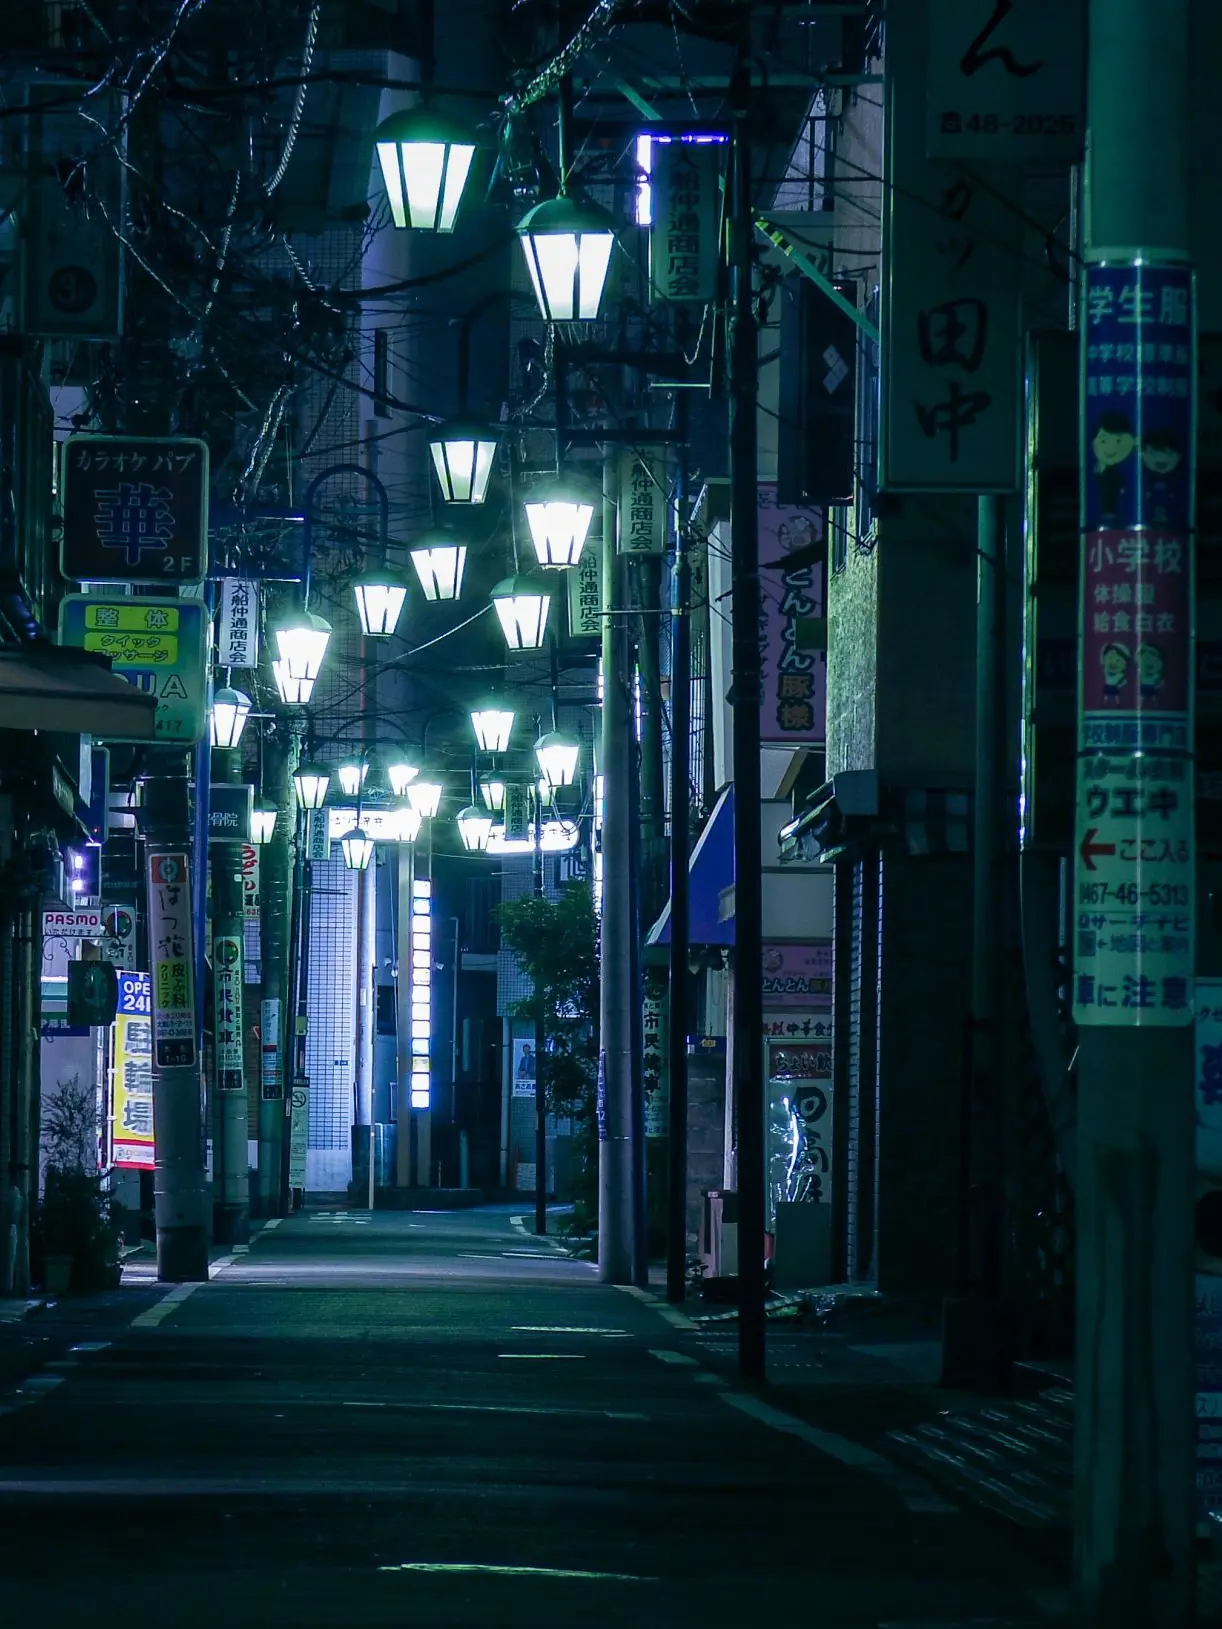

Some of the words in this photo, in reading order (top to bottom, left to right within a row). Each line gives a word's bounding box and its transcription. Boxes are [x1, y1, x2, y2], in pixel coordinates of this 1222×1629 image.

[966, 113, 1075, 134] 48-2025
[1088, 283, 1189, 326] 学生服
[914, 297, 992, 465] 田中
[630, 448, 654, 550] 大船仲通商店会
[93, 481, 176, 567] 華
[163, 556, 194, 573] 2F
[1089, 537, 1184, 574] 小学校
[95, 607, 169, 629] 整体
[229, 582, 250, 664] 大船仲通商店会
[98, 649, 169, 663] ッサージ
[101, 634, 161, 648] クイック
[1086, 784, 1178, 821] ウエキ
[1120, 839, 1189, 865] ここ入る
[45, 914, 99, 926] PASMO
[160, 963, 170, 1009] クリニック
[1077, 972, 1187, 1010] 車に注意
